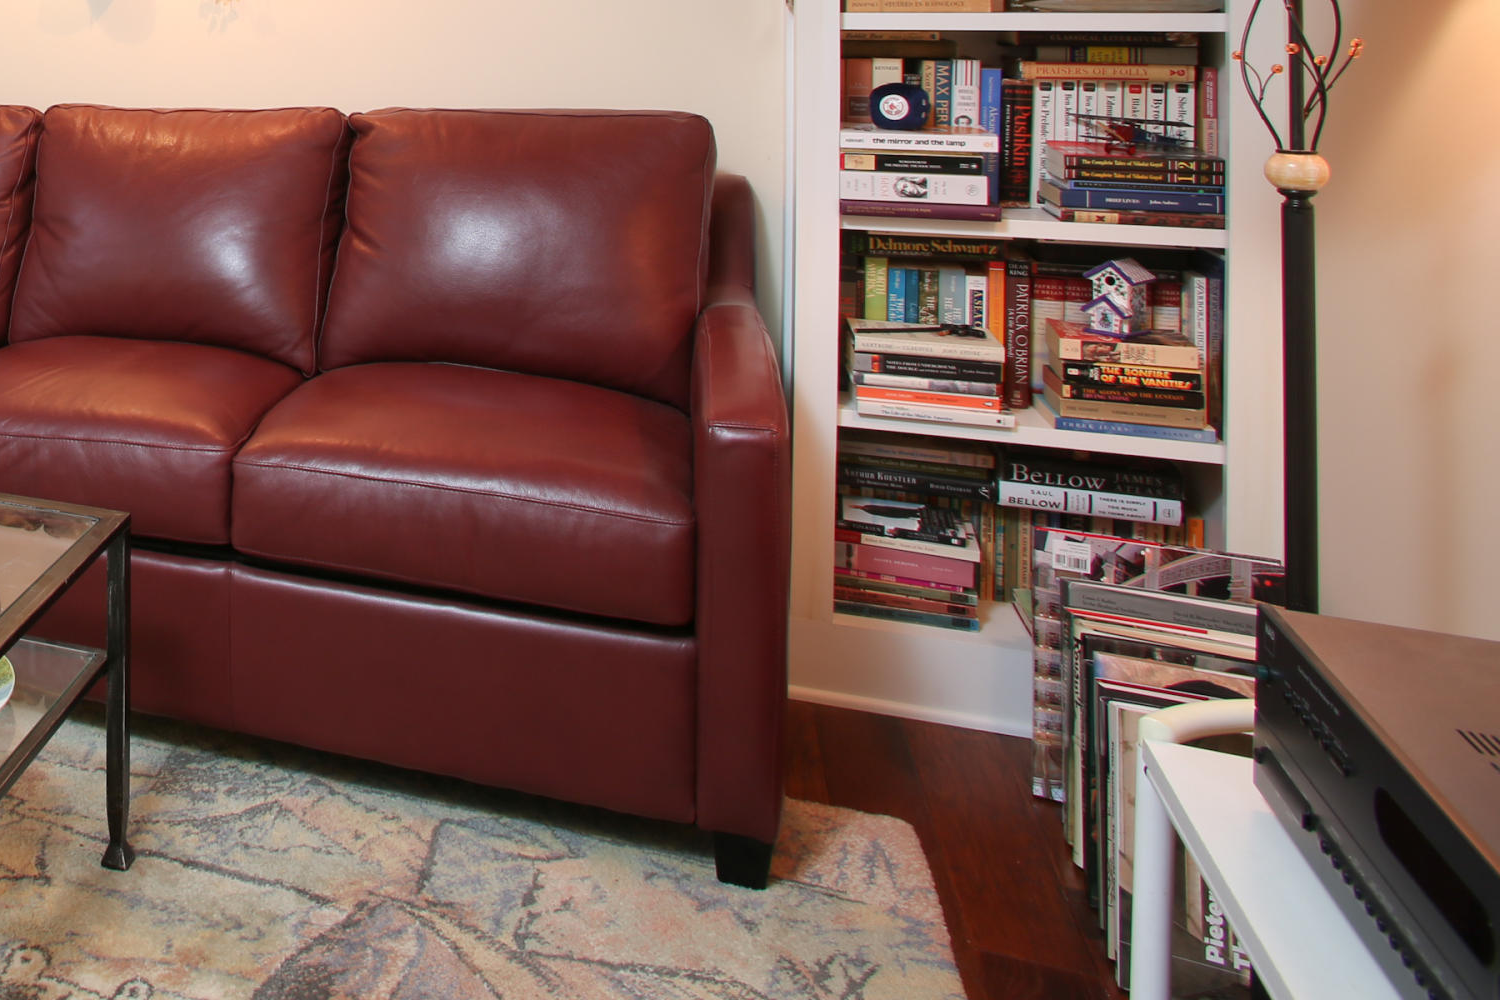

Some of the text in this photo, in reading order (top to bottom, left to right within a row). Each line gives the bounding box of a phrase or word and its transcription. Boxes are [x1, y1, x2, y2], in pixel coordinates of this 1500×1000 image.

[1036, 67, 1148, 76] PRAISERS OF FOLLY
[936, 64, 949, 96] MAX
[1132, 98, 1140, 118] Blake
[1040, 95, 1050, 139] The Prelude:
[914, 138, 930, 146] and
[1013, 105, 1032, 166] Pushkin
[1177, 161, 1195, 170] 2
[868, 237, 929, 251] Delmore
[931, 239, 997, 255] Schwartz
[867, 263, 876, 299] AMERICA
[876, 267, 887, 295] NORTH
[973, 299, 983, 318] SEA
[1195, 279, 1205, 350] HARBORS HIGH
[1015, 283, 1029, 385] PATRICK O'BRIAN
[1101, 367, 1172, 379] THE BONFIRE
[1101, 374, 1192, 388] OF THE VANITIES
[845, 469, 916, 484] ARTHUR KOESTLER
[1115, 473, 1162, 485] JAMES
[1030, 489, 1052, 497] SAUL
[1116, 484, 1162, 496] ATLAS
[1008, 496, 1061, 509] BELLOW
